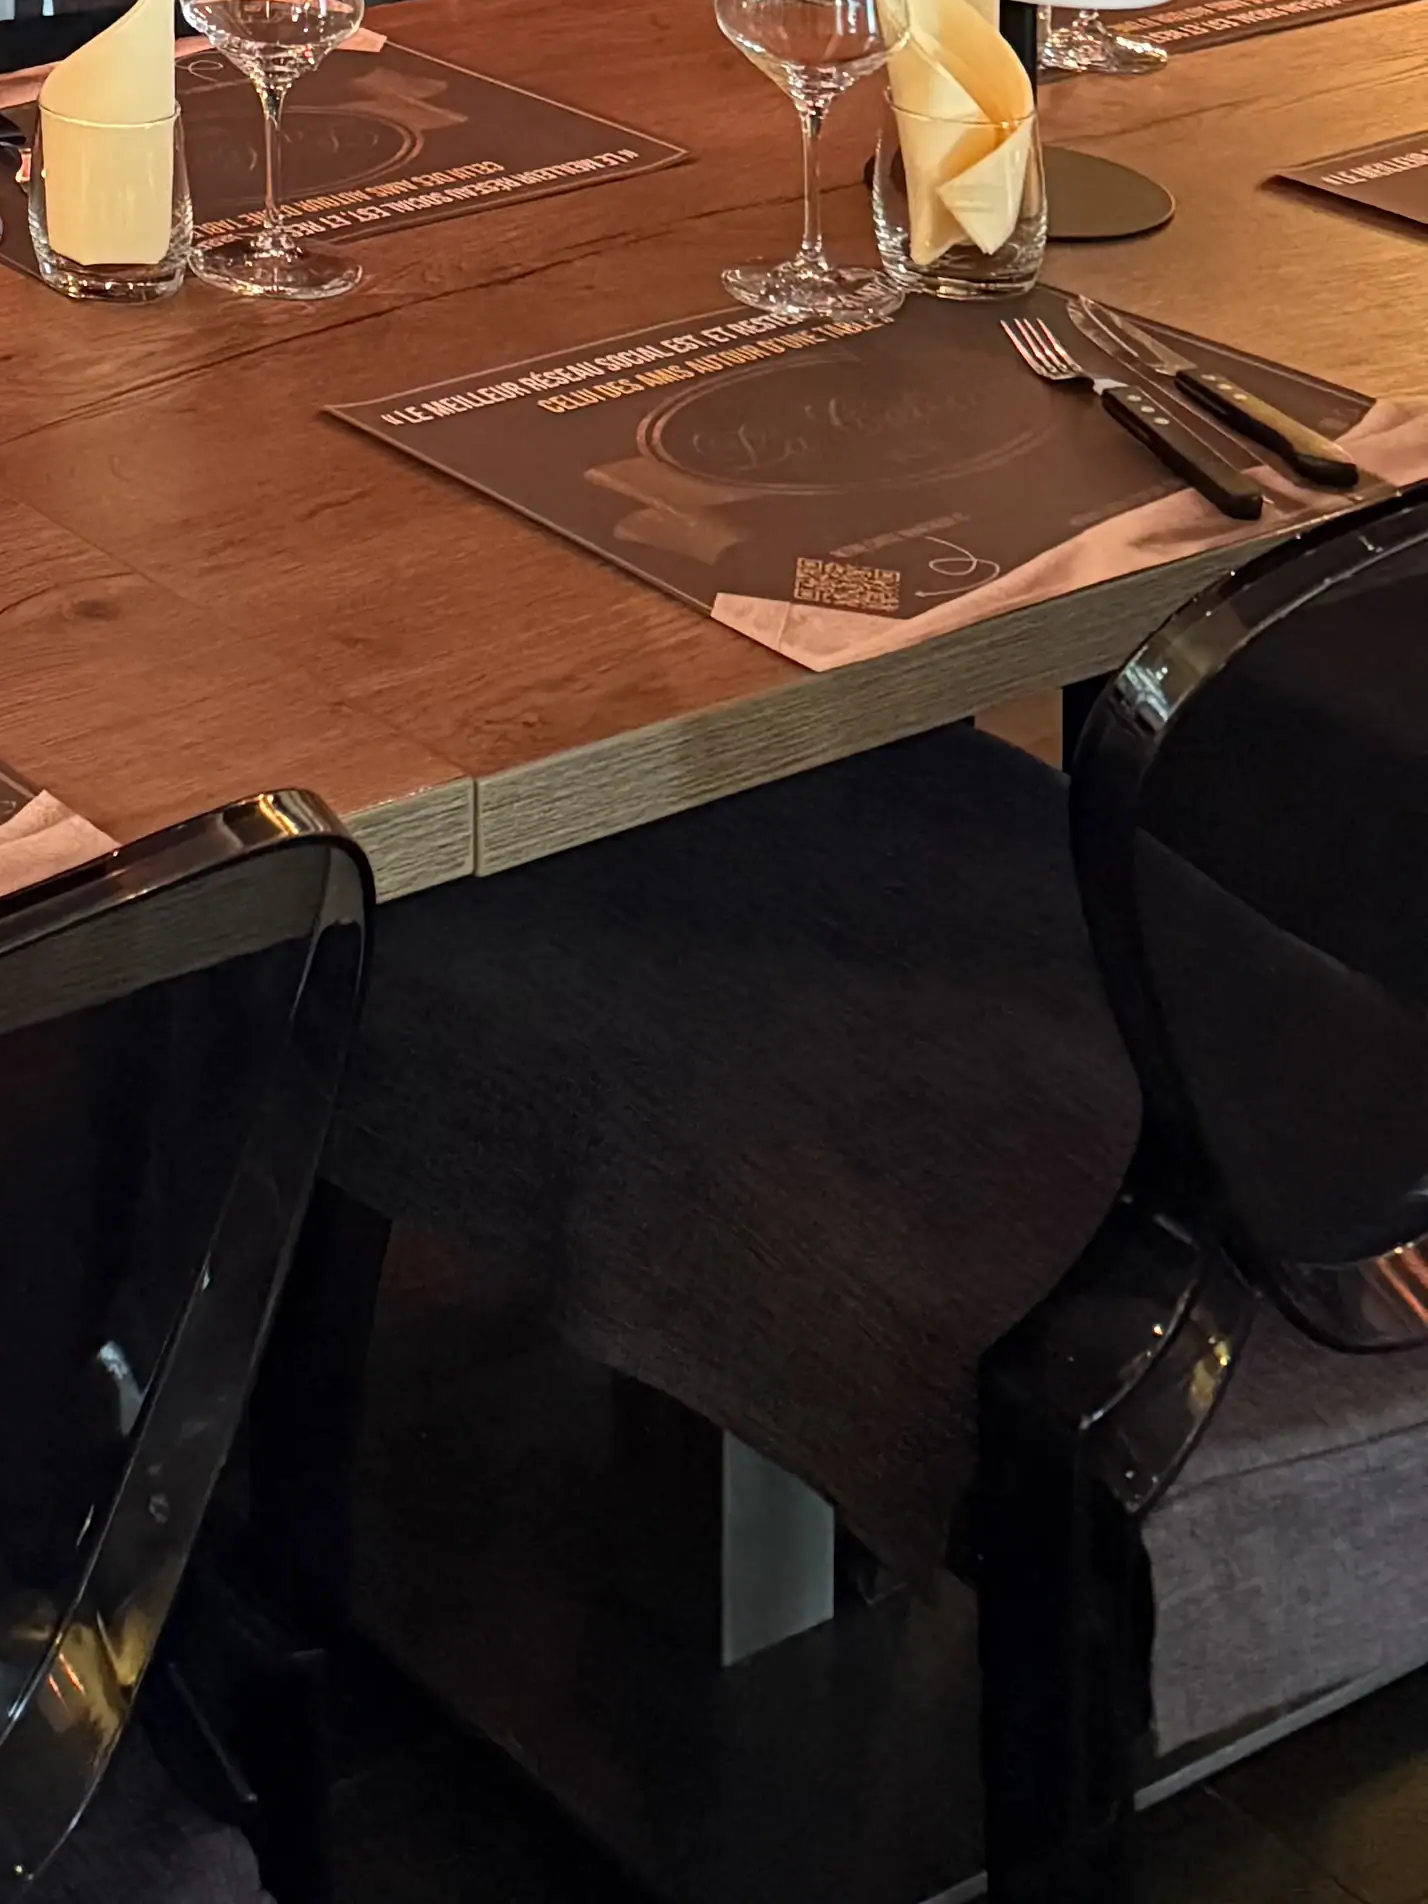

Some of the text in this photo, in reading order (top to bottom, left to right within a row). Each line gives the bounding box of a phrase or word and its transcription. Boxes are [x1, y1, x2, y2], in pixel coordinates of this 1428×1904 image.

[410, 172, 457, 188] DES
[444, 175, 522, 200] RÉSEAU
[380, 192, 454, 213] SOCIAL
[394, 404, 435, 424] LE
[421, 381, 532, 419] MEILLEUR
[518, 360, 605, 392] RÉSEAU
[594, 344, 675, 372] SOCIAL
[660, 334, 716, 355] EST,
[701, 326, 739, 343] ET
[537, 387, 607, 414] CELUI
[594, 378, 645, 399] DES
[635, 363, 695, 388] AMIS
[685, 345, 772, 376] AUTOUR
[756, 329, 828, 354] D'UNE
